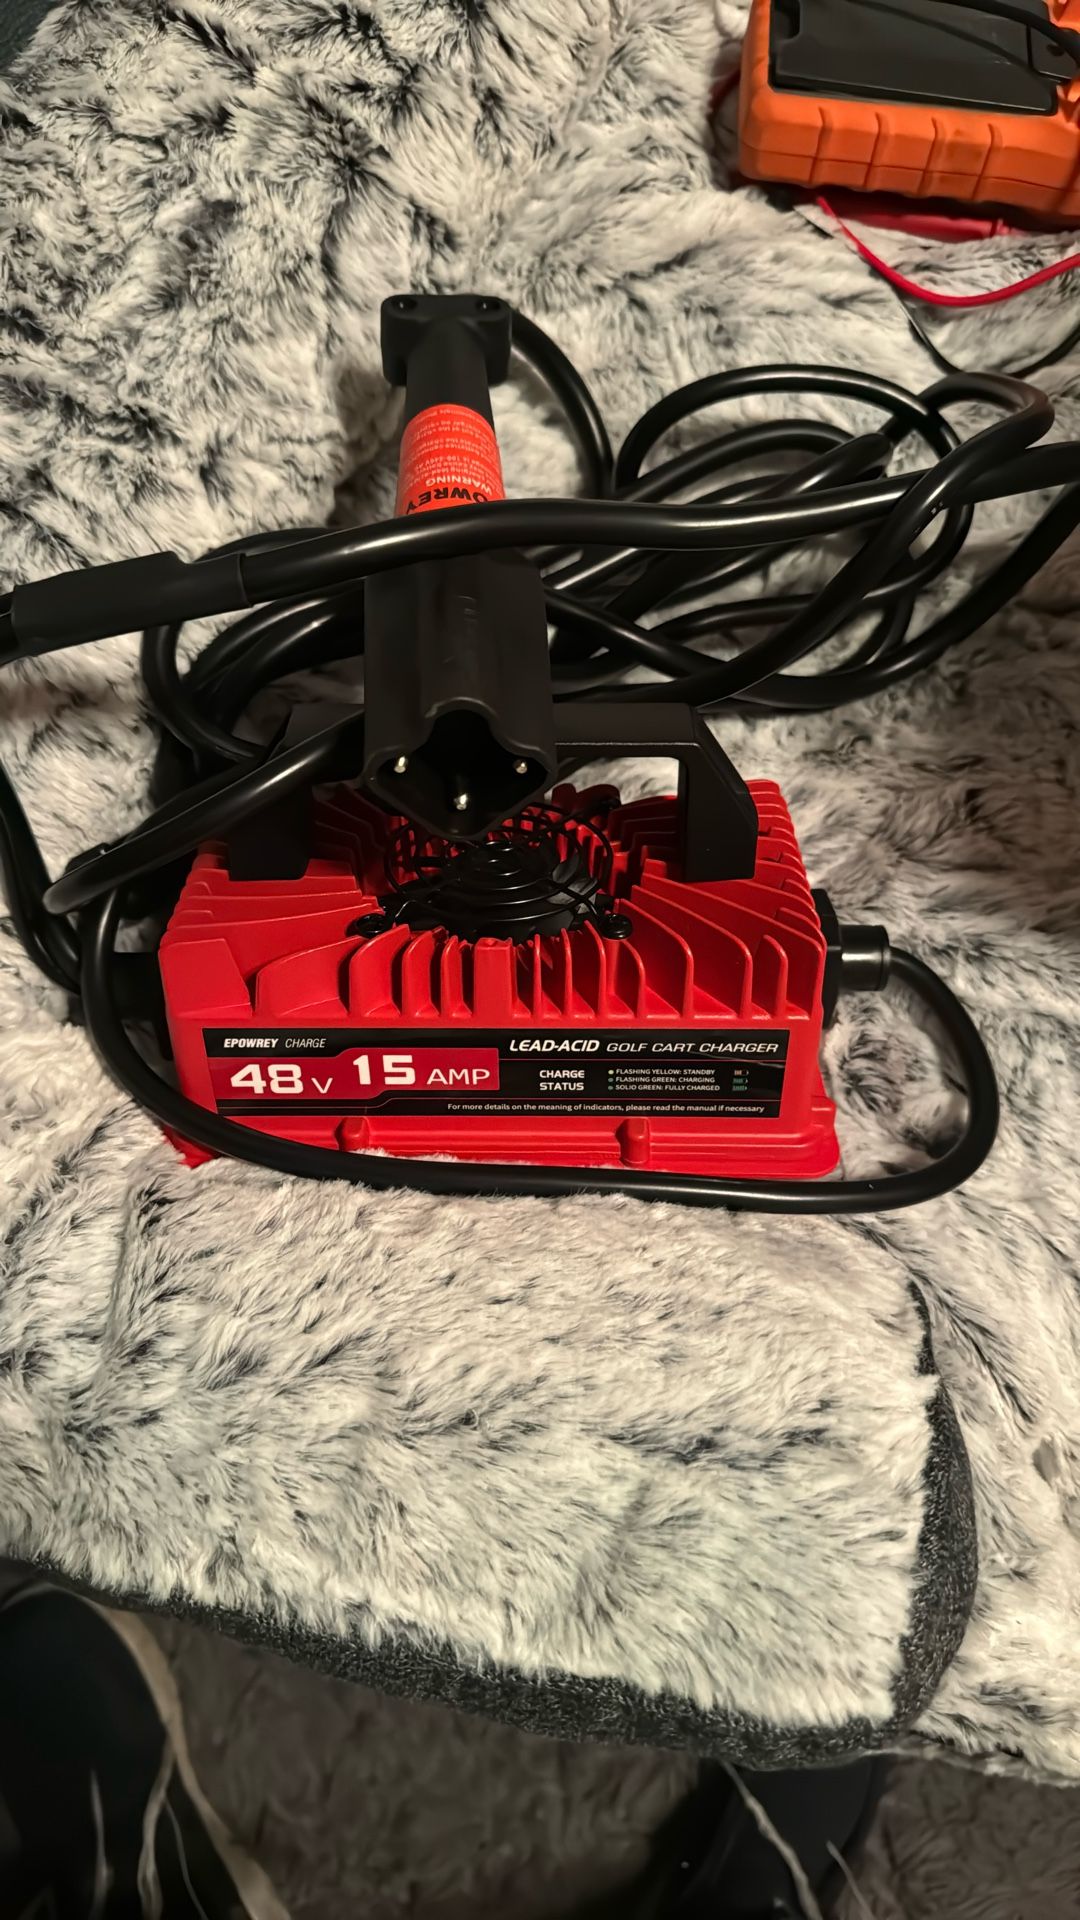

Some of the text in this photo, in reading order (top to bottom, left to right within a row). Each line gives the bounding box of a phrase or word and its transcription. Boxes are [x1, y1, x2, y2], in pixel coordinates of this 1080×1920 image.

[426, 475, 492, 496] WARNING
[223, 1038, 327, 1048] EPOWREY CHARGE
[509, 1039, 779, 1053] LEAD-ACID GOLF CART CHARGER
[230, 1063, 304, 1094] 48
[352, 1054, 416, 1085] 15
[426, 1068, 490, 1085] AMP
[539, 1070, 585, 1079] CHARGE
[539, 1082, 585, 1091] STATUS
[538, 1103, 573, 1112] meaning
[583, 1103, 624, 1112] indicators,
[625, 1104, 651, 1112] please
[687, 1104, 717, 1112] manual
[725, 1105, 765, 1113] necessary
